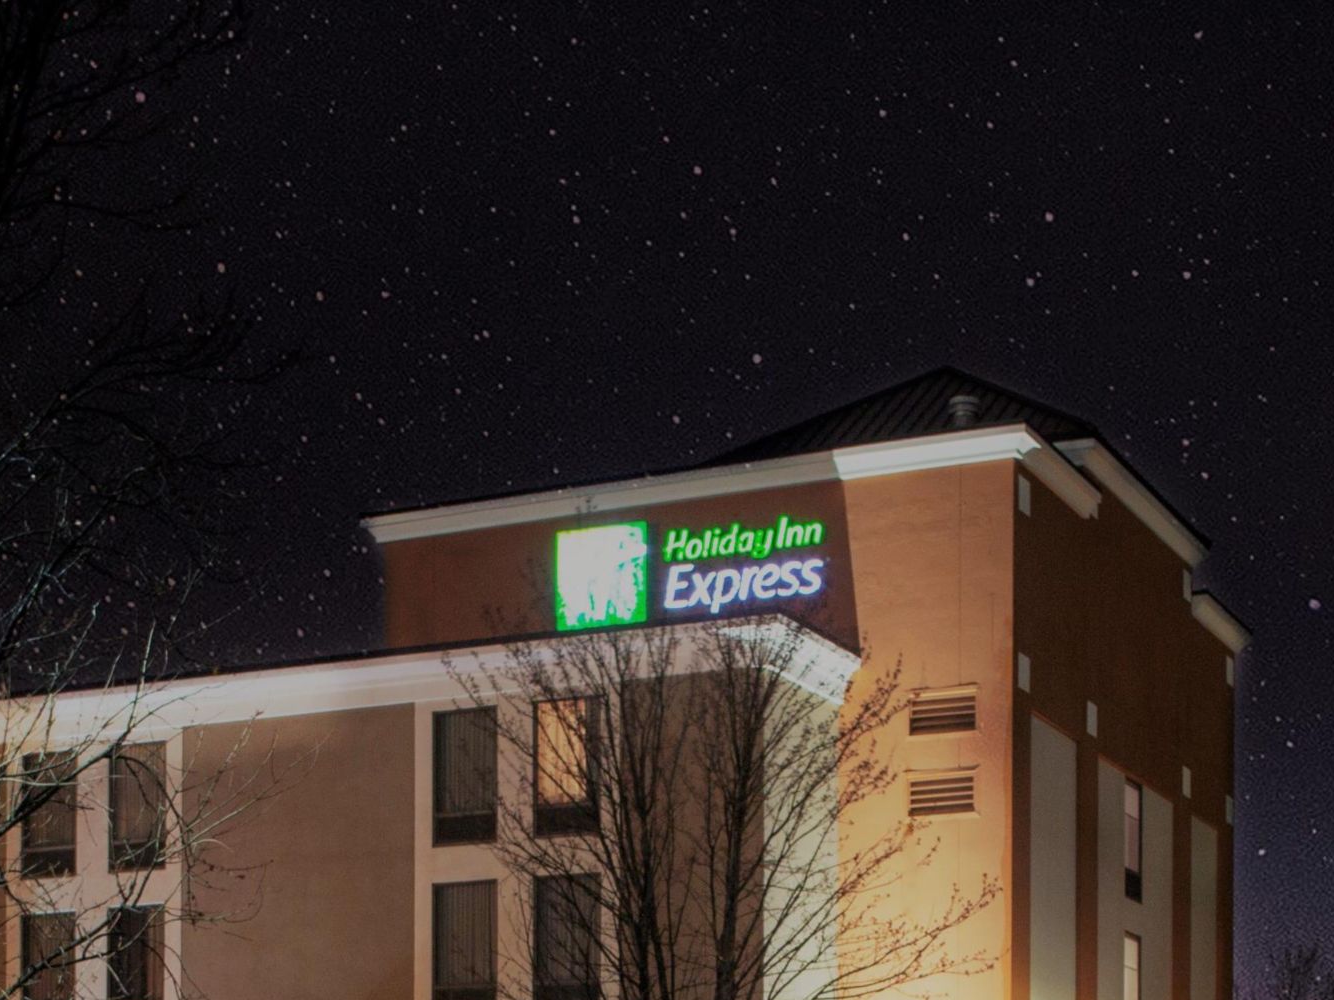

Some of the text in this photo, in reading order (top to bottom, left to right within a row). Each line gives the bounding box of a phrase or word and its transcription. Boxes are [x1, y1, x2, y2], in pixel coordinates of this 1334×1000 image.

[663, 515, 823, 561] Holiday Inn
[663, 559, 824, 613] Express
